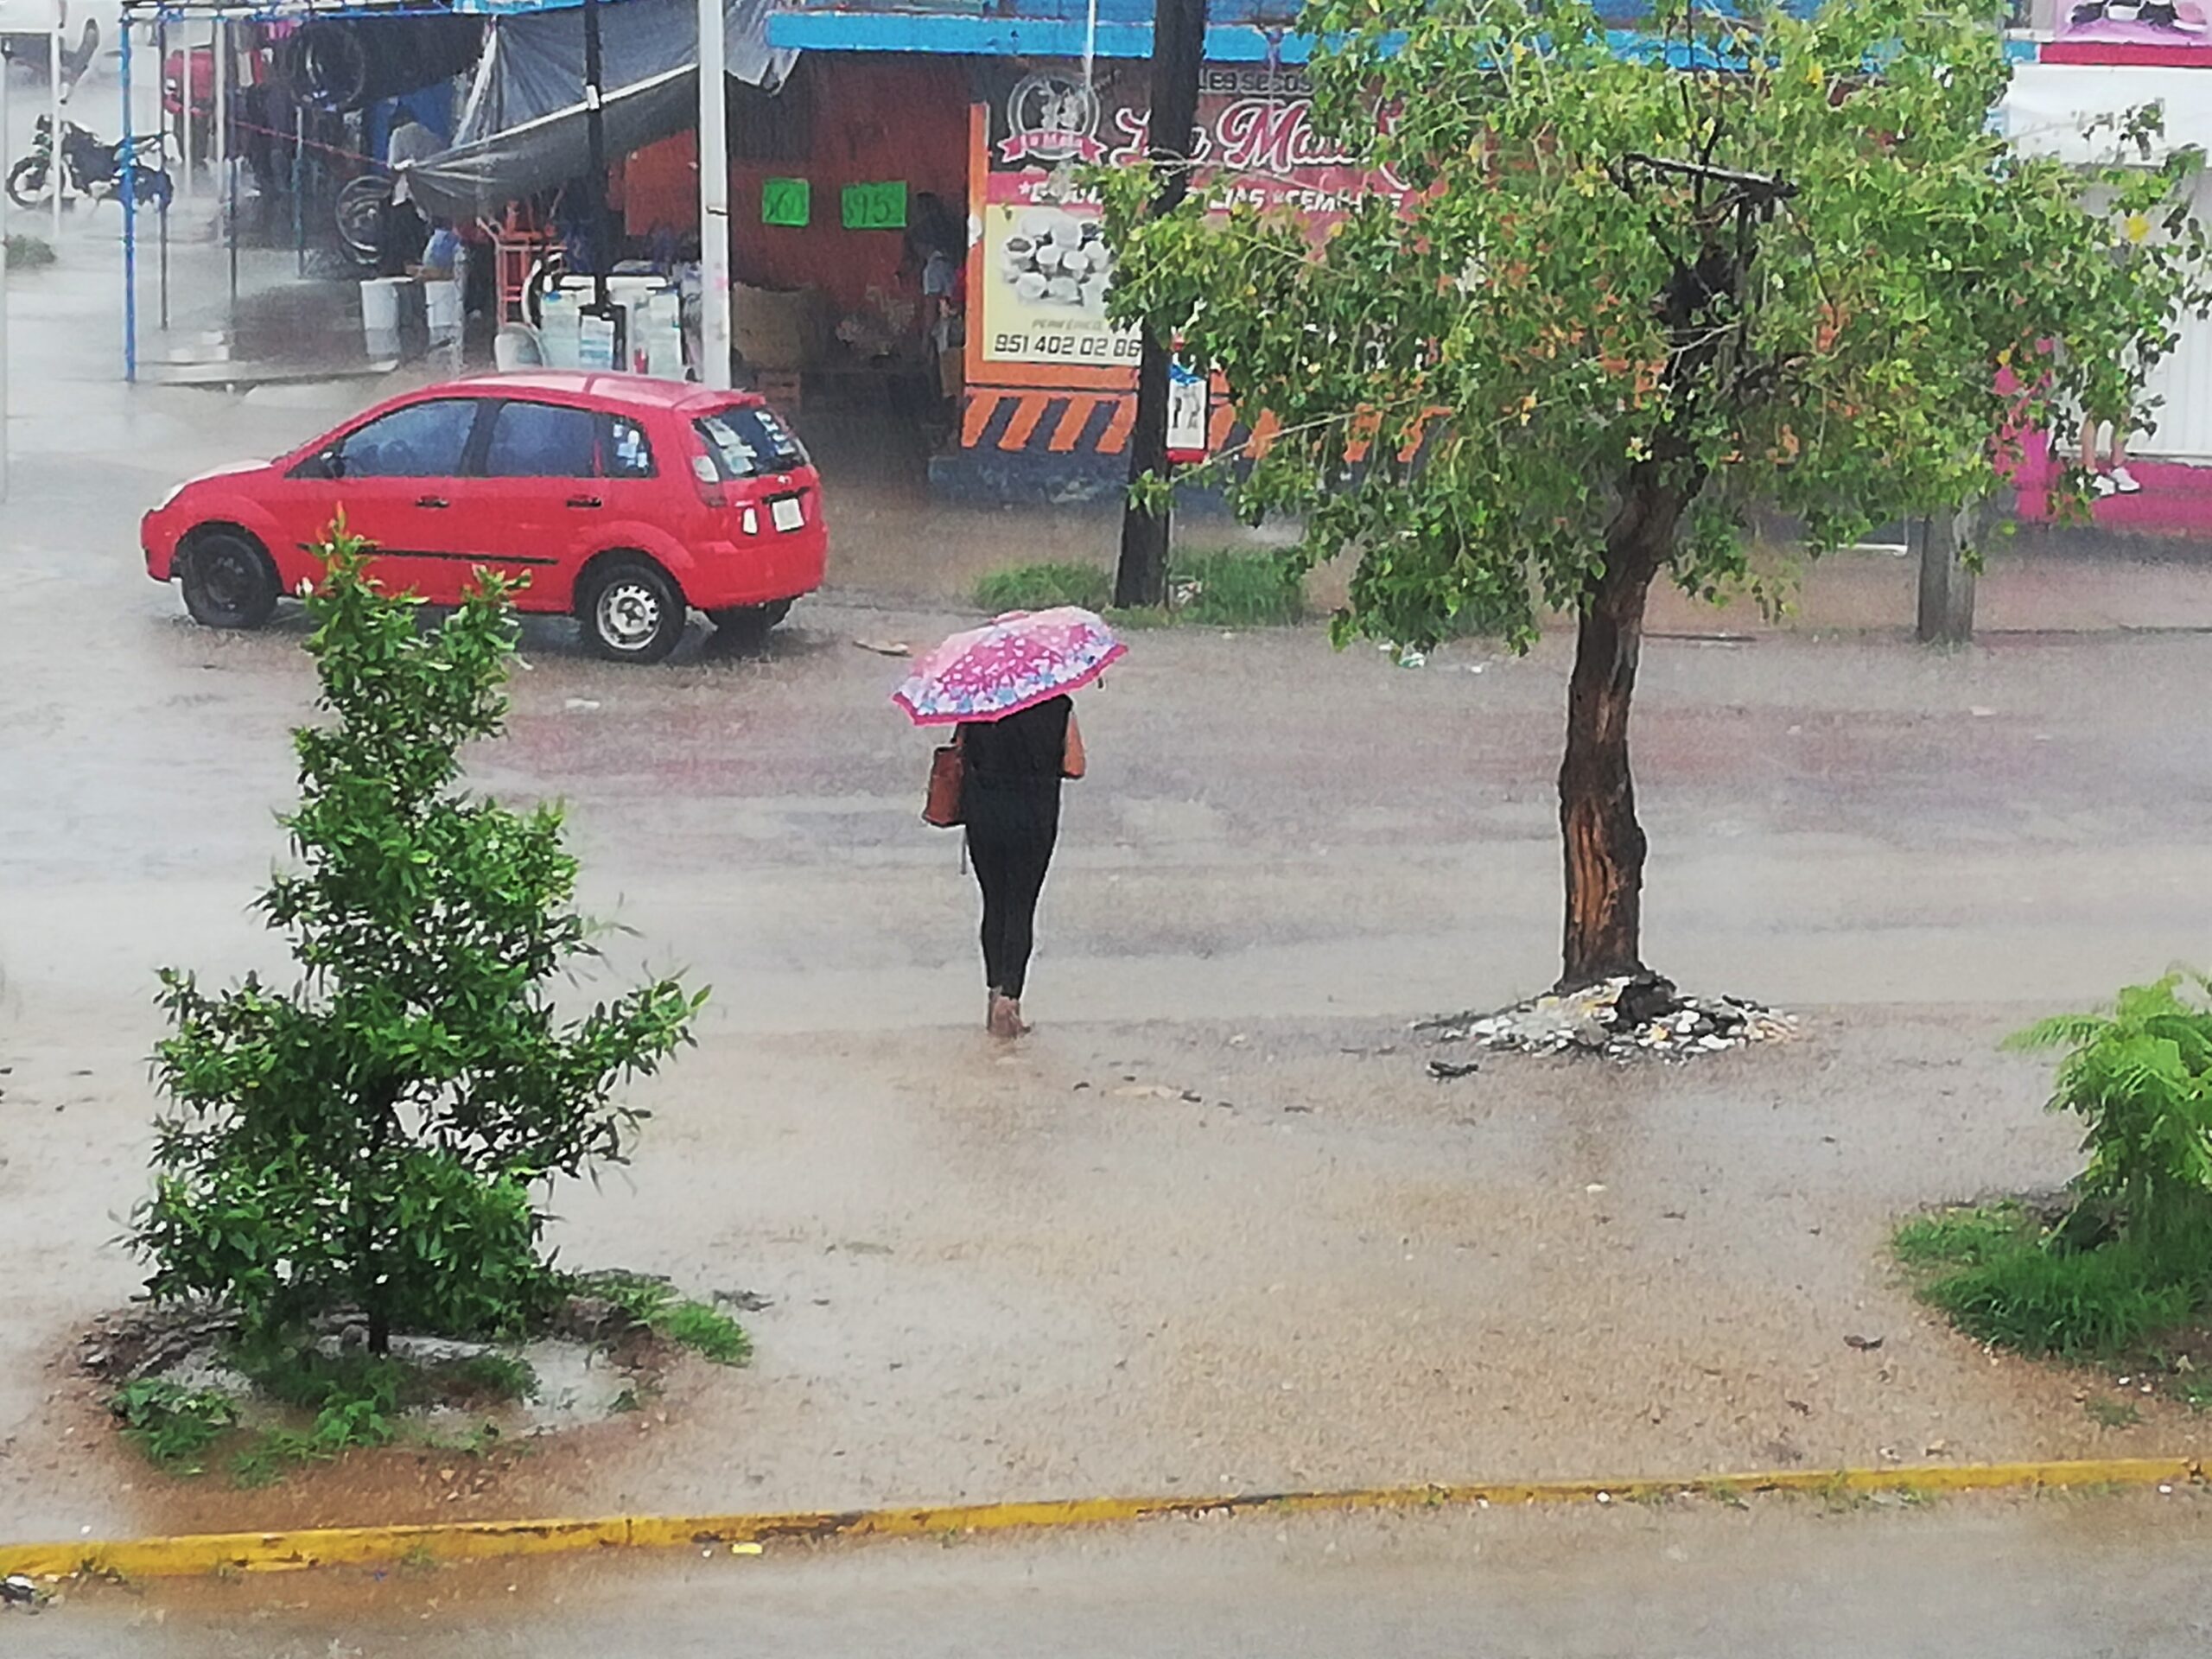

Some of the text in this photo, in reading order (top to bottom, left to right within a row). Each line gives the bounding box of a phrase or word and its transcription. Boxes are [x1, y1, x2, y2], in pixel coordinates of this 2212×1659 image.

[994, 334, 1029, 353] 951
[1034, 335, 1075, 355] 402
[1080, 337, 1109, 357] 02
